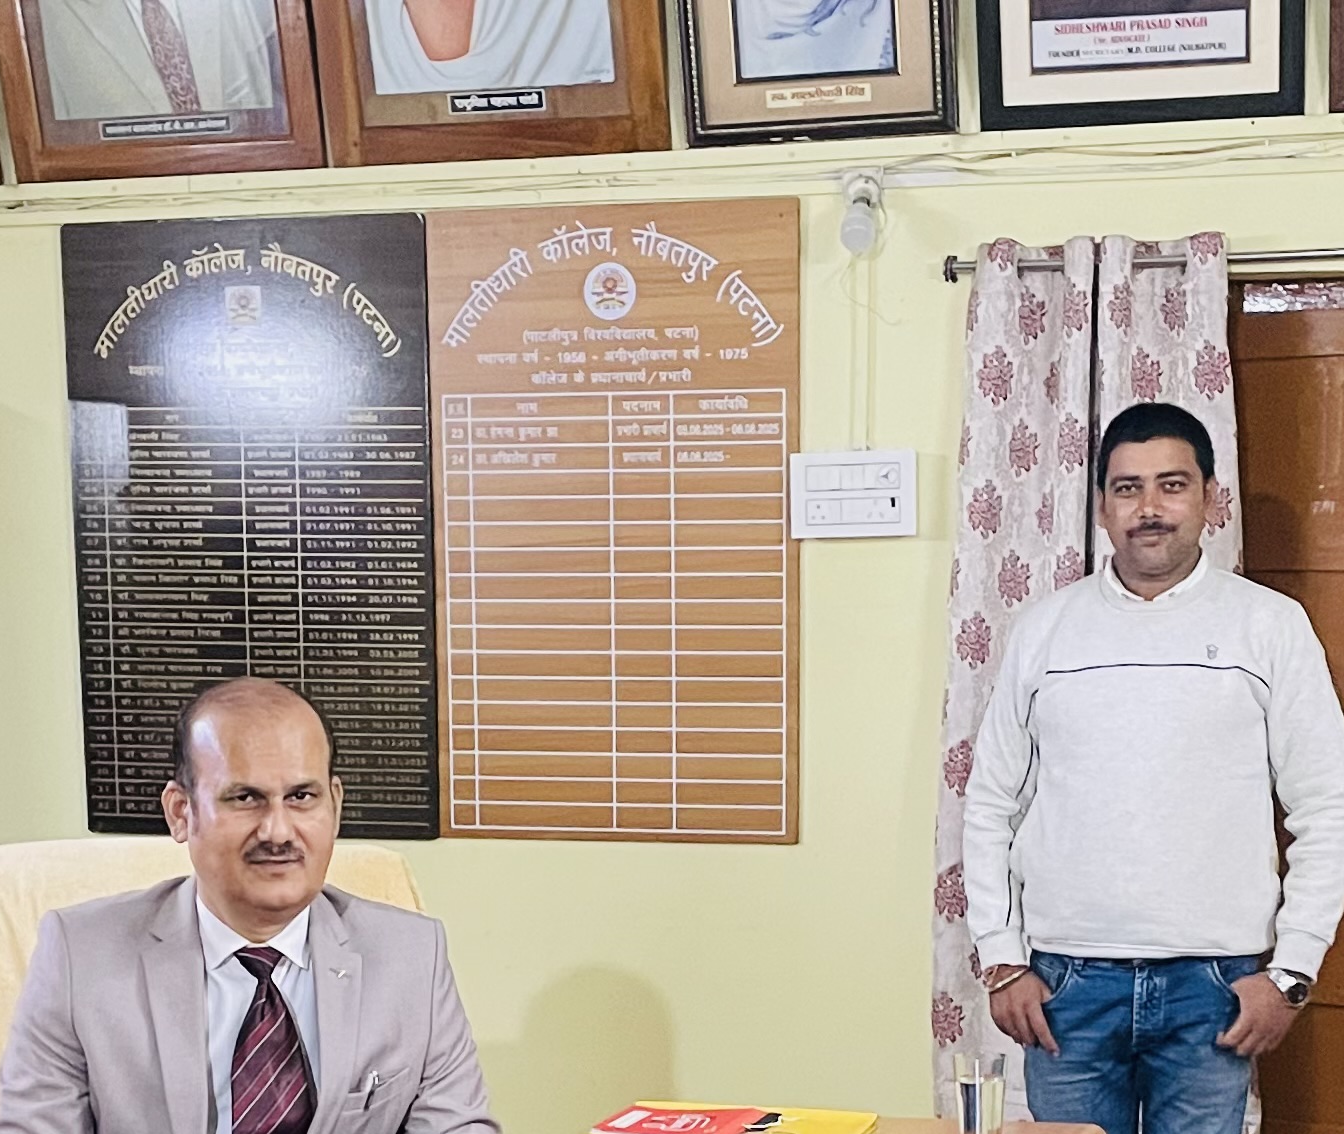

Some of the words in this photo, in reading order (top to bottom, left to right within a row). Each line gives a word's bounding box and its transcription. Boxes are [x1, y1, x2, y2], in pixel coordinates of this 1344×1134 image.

[1130, 18, 1171, 32] PRASAD
[1175, 16, 1208, 29] SINGH
[343, 282, 402, 358] (पटना)
[441, 248, 533, 347] मालतीधारी
[631, 221, 719, 283] नौबतपुर
[716, 270, 784, 346] (पटना)
